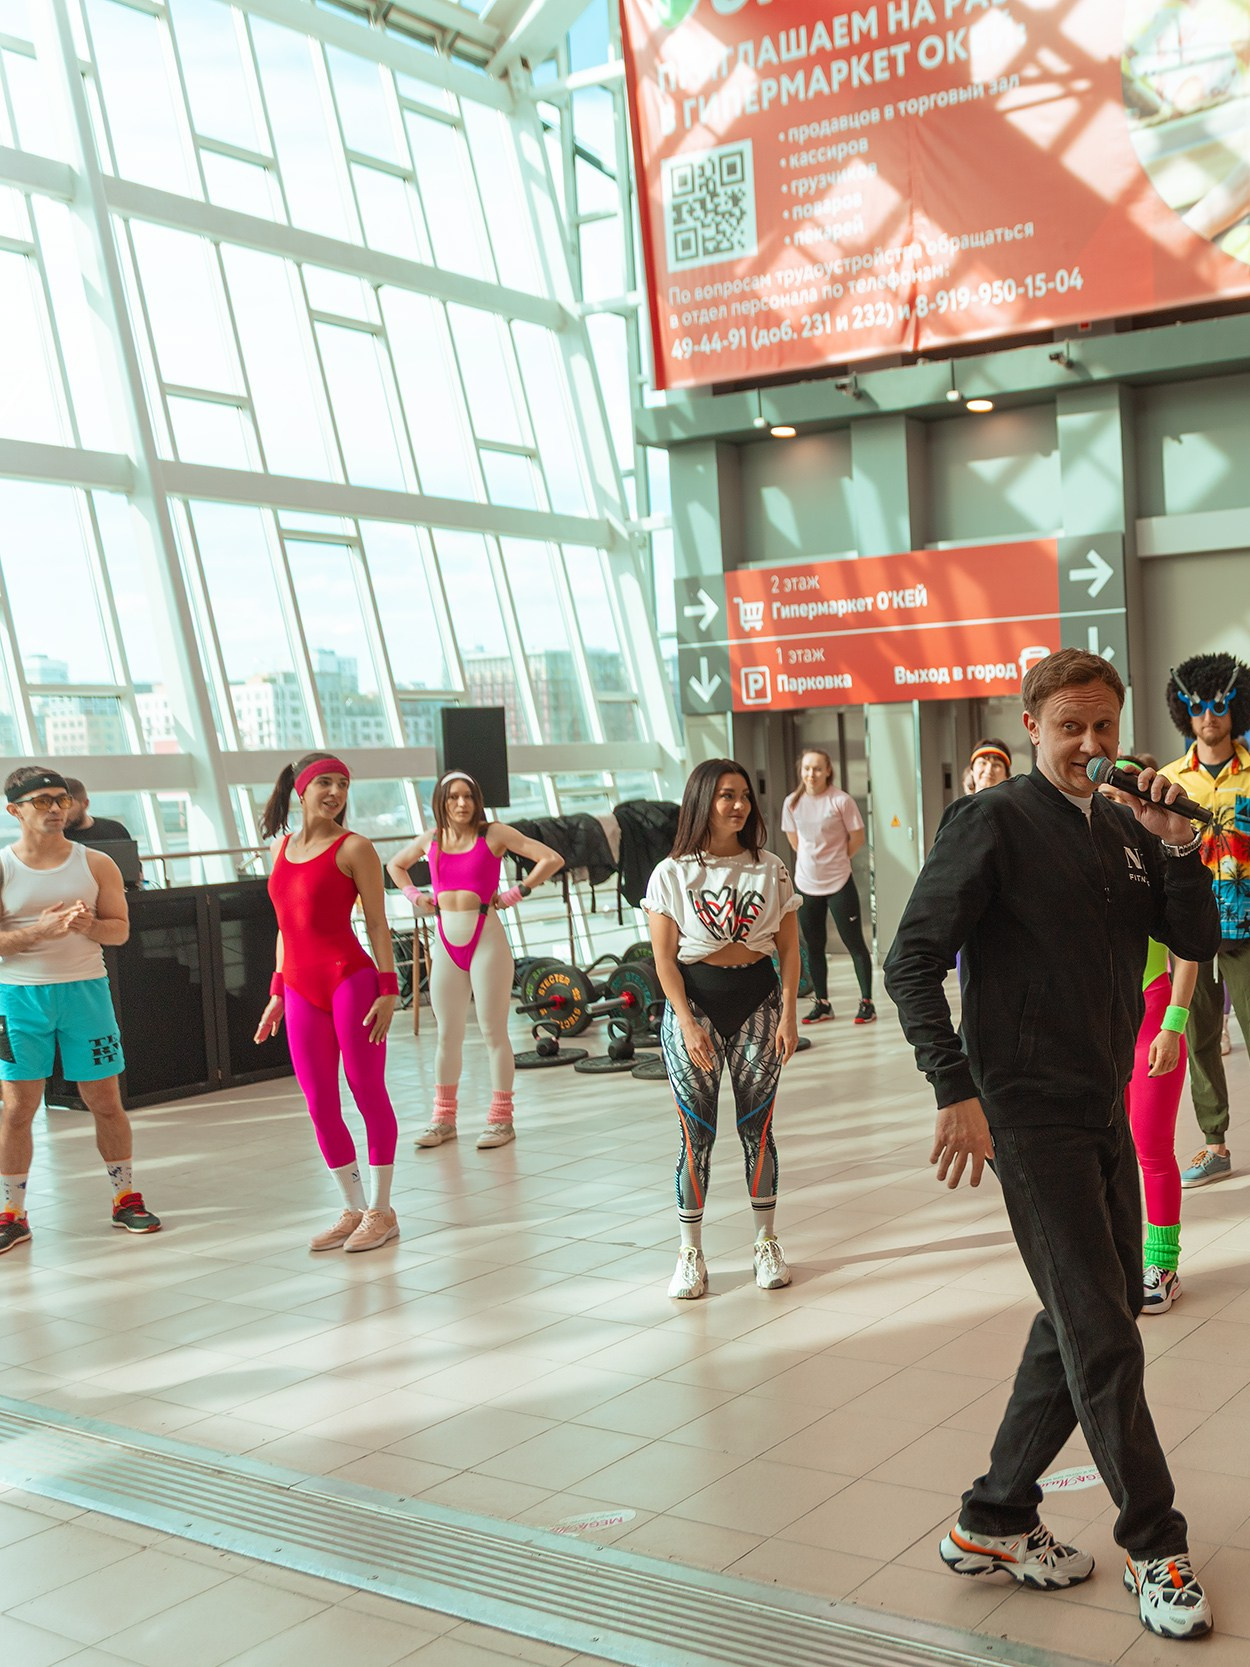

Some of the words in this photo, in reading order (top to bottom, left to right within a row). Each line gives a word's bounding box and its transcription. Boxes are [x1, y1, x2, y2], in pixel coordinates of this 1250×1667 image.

[887, 0, 936, 35] НА
[788, 108, 880, 144] продавцов
[884, 104, 895, 121] в
[897, 81, 985, 117] торговый
[988, 73, 1020, 96] зал
[789, 137, 869, 169] кассиров
[790, 162, 878, 198] грузчиков
[792, 192, 863, 222] поваров
[793, 214, 864, 247] пекарей
[668, 285, 691, 306] По
[694, 272, 773, 301] вопросам
[775, 242, 922, 287] трудоустройства
[925, 221, 1034, 257] обращаться
[669, 314, 679, 330] в
[682, 305, 728, 326] отдел
[731, 288, 818, 317] персонала
[821, 282, 843, 299] по
[847, 262, 950, 295] телефонам:
[670, 326, 747, 360] 49-44-91
[751, 319, 798, 351] (доб.
[800, 311, 832, 339] 231
[835, 314, 849, 332] и
[851, 301, 894, 330] 232)
[897, 303, 911, 321] и
[915, 266, 1084, 319] 8-919-950-15-04
[770, 575, 780, 594] 2
[783, 575, 820, 593] этаж
[772, 596, 874, 621] Гипермаркет
[876, 584, 928, 611] О'КЕЙ
[776, 647, 783, 664] 1
[788, 647, 825, 664] этаж
[777, 673, 852, 695] Парковка
[894, 665, 950, 685] Выход
[952, 666, 963, 681] в
[967, 663, 1017, 683] город
